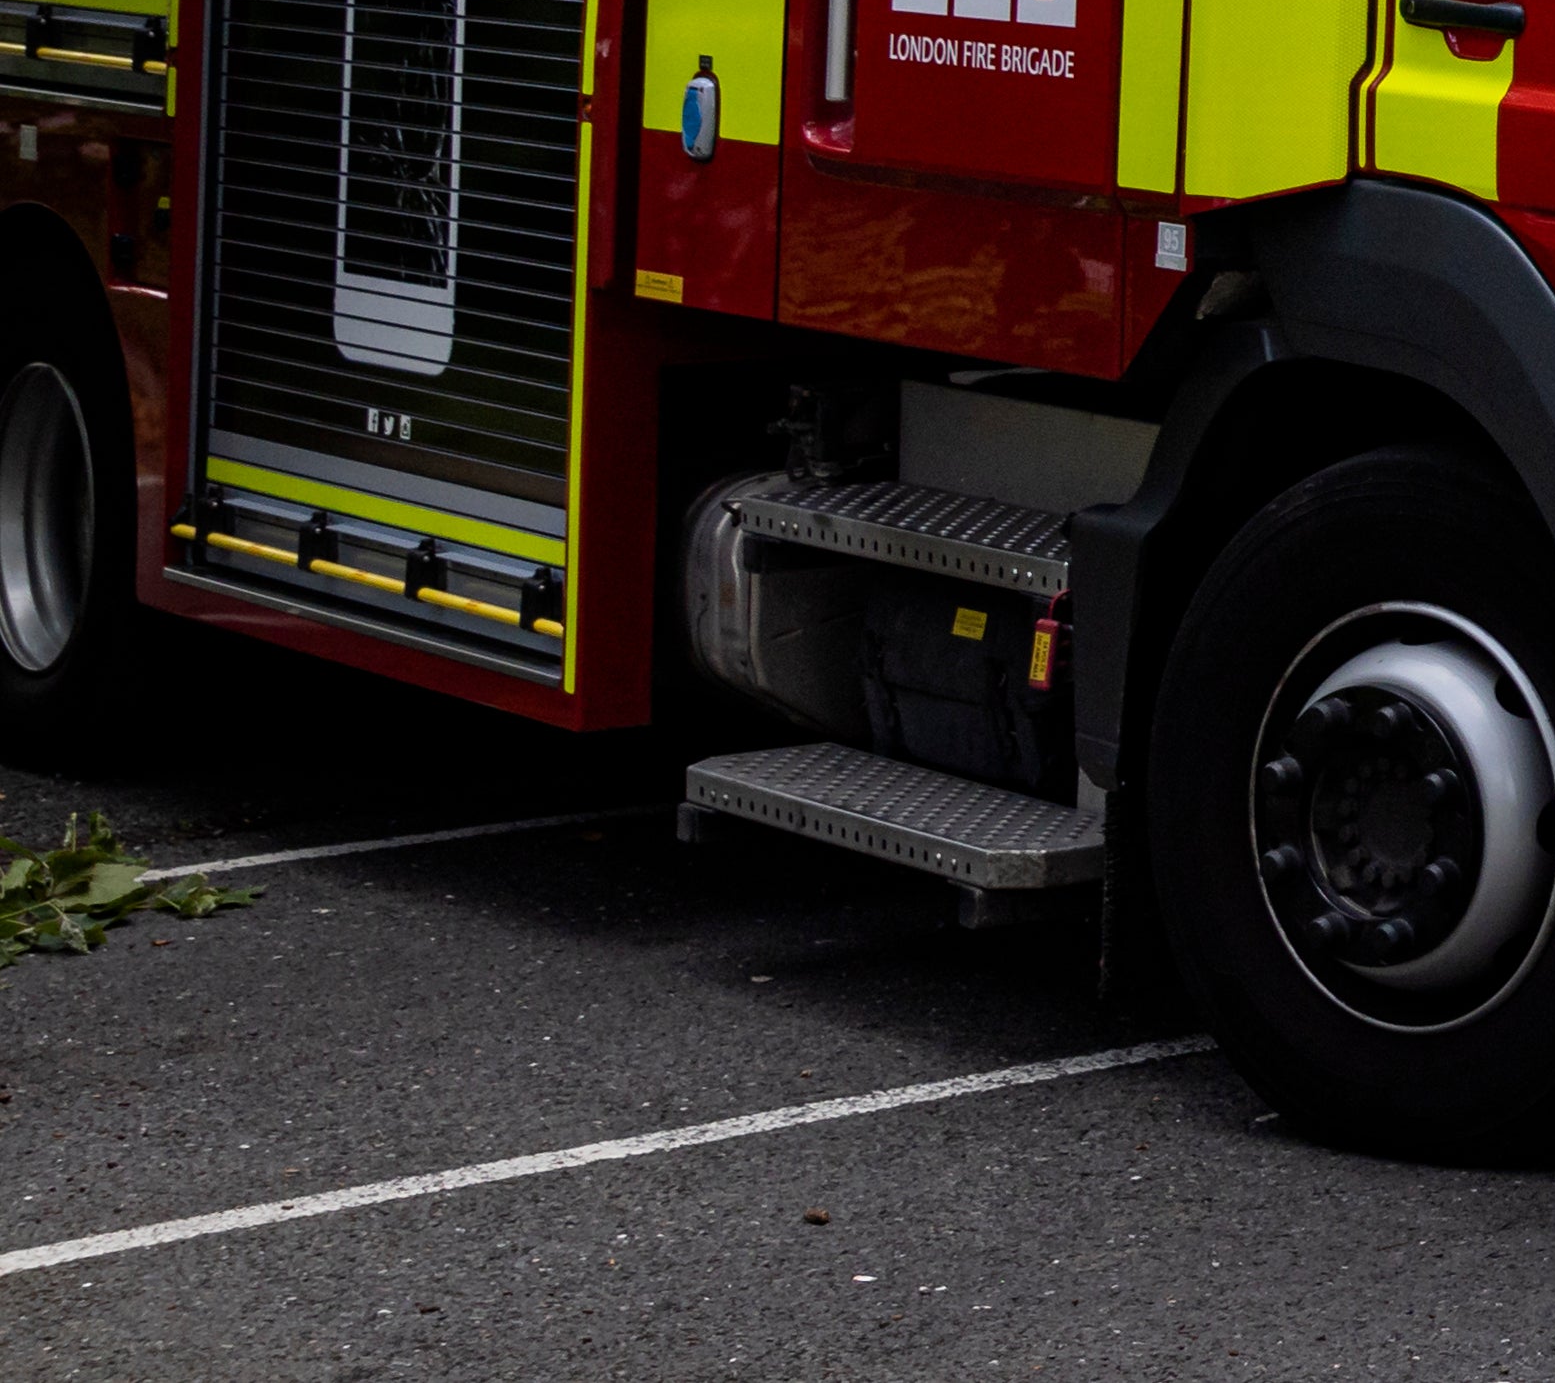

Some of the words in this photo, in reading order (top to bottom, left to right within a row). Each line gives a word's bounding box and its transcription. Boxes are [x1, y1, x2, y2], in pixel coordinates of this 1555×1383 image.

[888, 33, 959, 67] LONDON
[963, 40, 997, 71] FIRE
[1001, 44, 1076, 79] BRIGADE
[1163, 228, 1180, 252] 95
